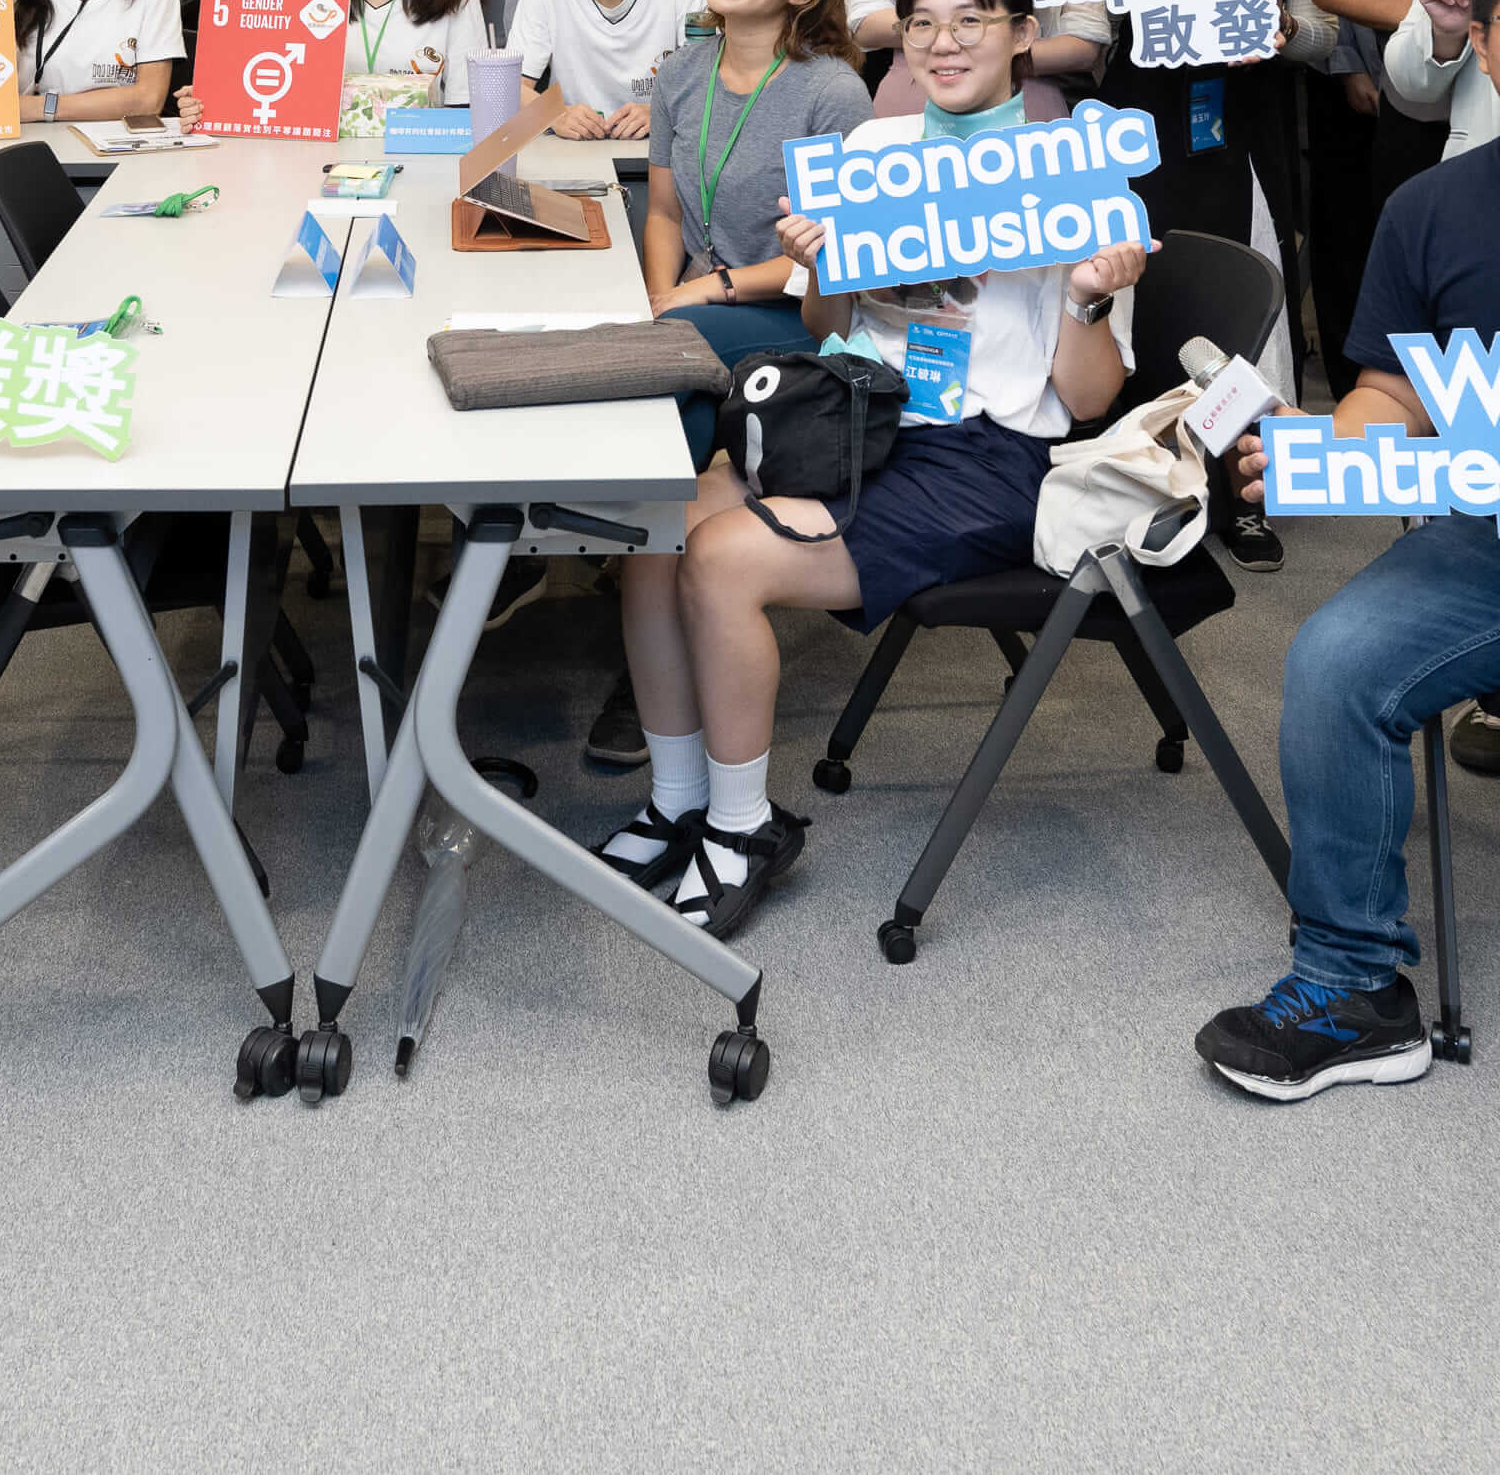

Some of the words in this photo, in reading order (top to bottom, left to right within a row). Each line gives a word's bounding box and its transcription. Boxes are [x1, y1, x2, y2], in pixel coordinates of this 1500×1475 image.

[240, 13, 292, 30] EQUALITY
[796, 111, 1149, 210] Economic
[822, 195, 1140, 281] Inclusion
